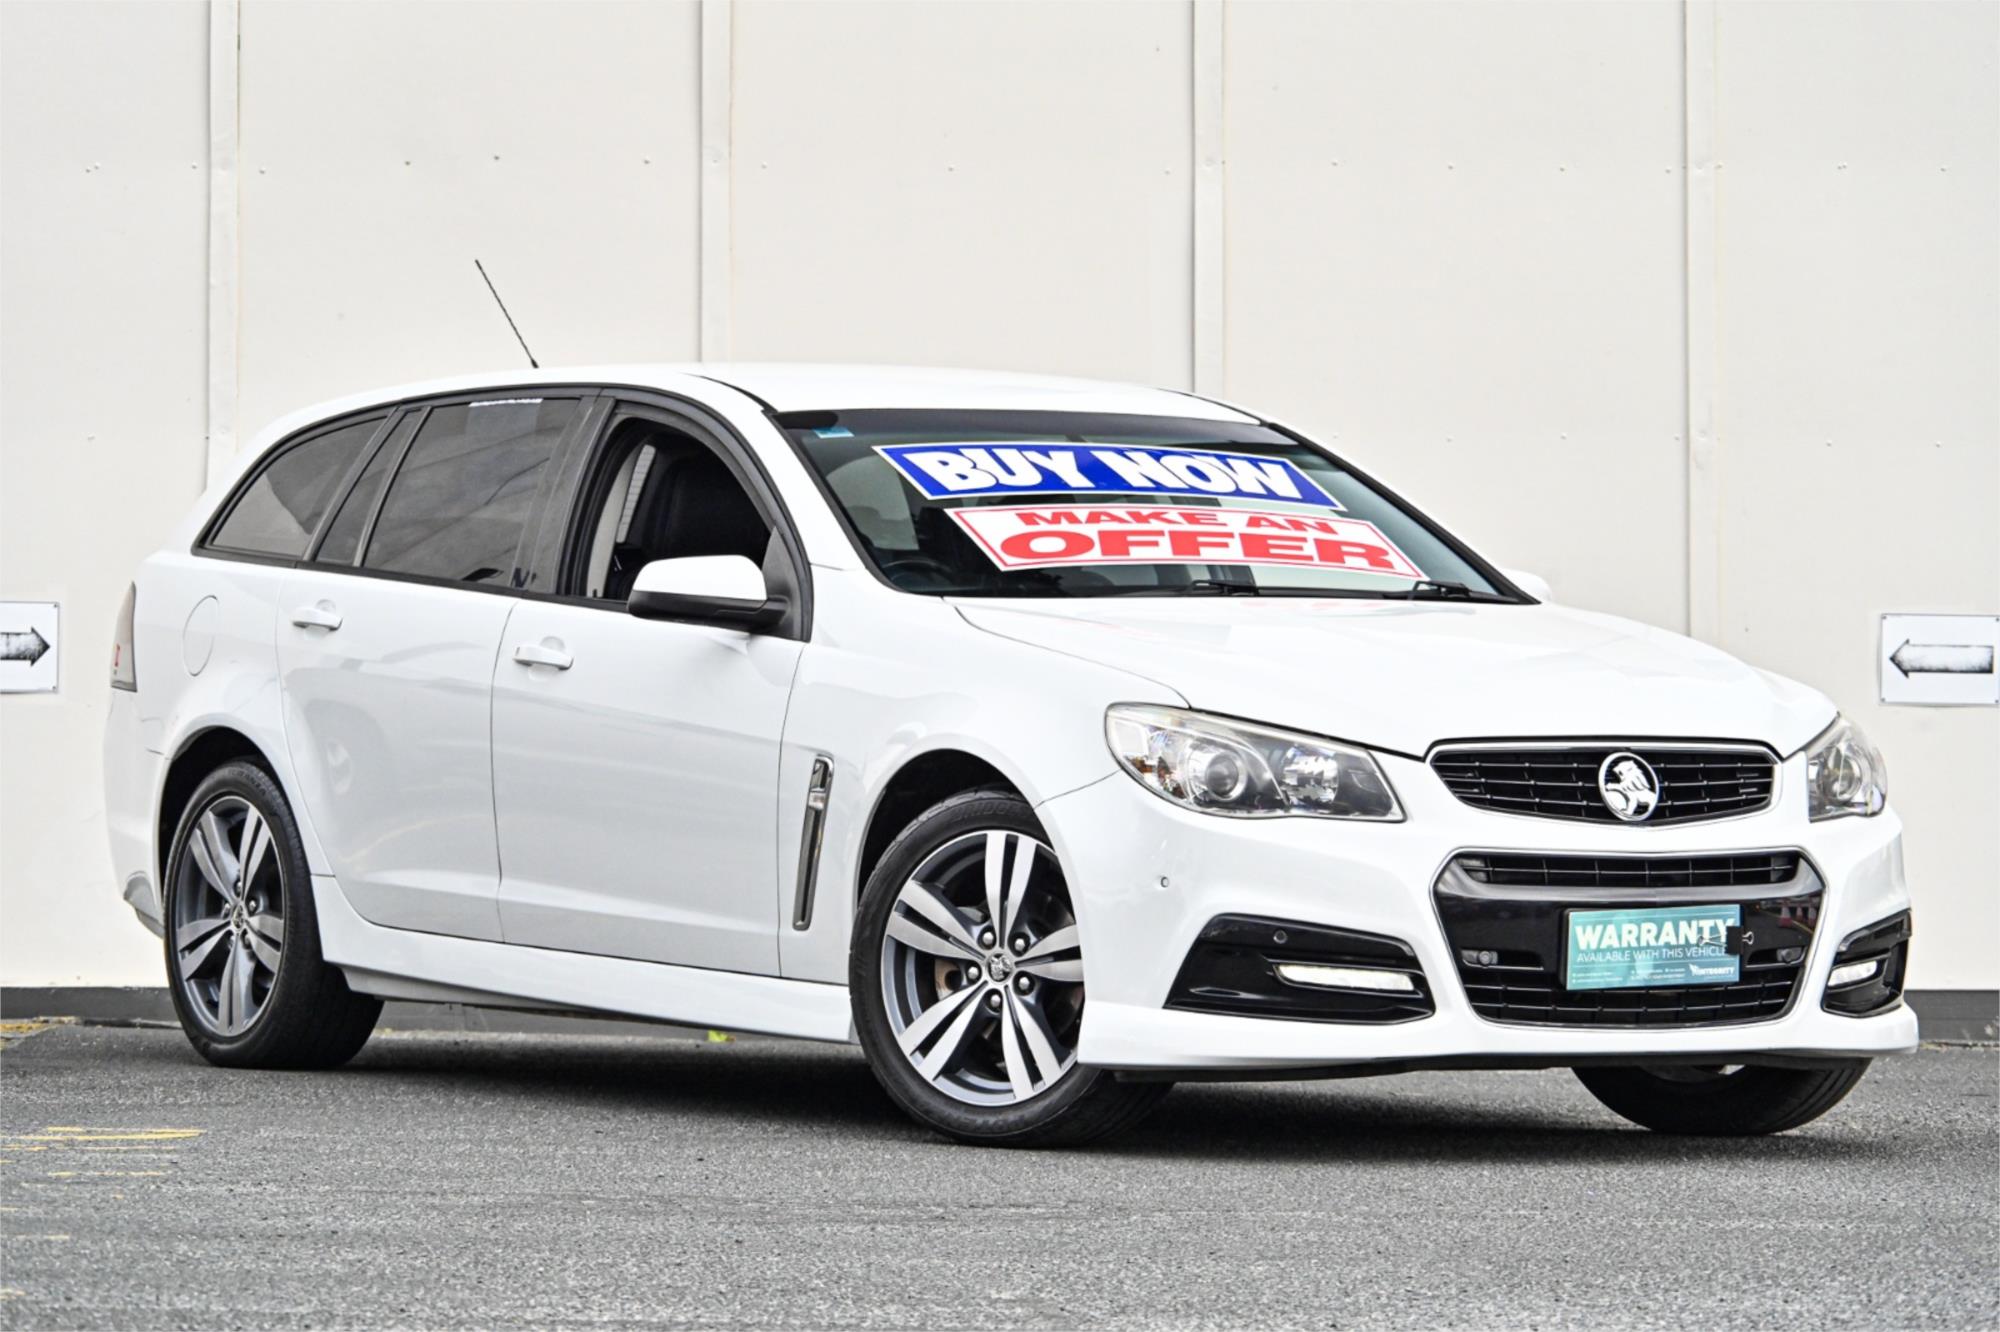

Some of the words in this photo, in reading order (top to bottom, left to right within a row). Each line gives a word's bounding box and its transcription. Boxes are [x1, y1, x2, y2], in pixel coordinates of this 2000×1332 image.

[902, 448, 1096, 491] BUY
[1089, 449, 1303, 499] NOW
[1015, 511, 1228, 527] MAKE
[1246, 515, 1339, 535] AN
[1000, 530, 1396, 570] OFFER
[1575, 918, 1735, 950] WARRANTY
[1577, 951, 1631, 963] AVAILABLE
[1633, 948, 1660, 961] WITH
[1662, 947, 1684, 959] THIS
